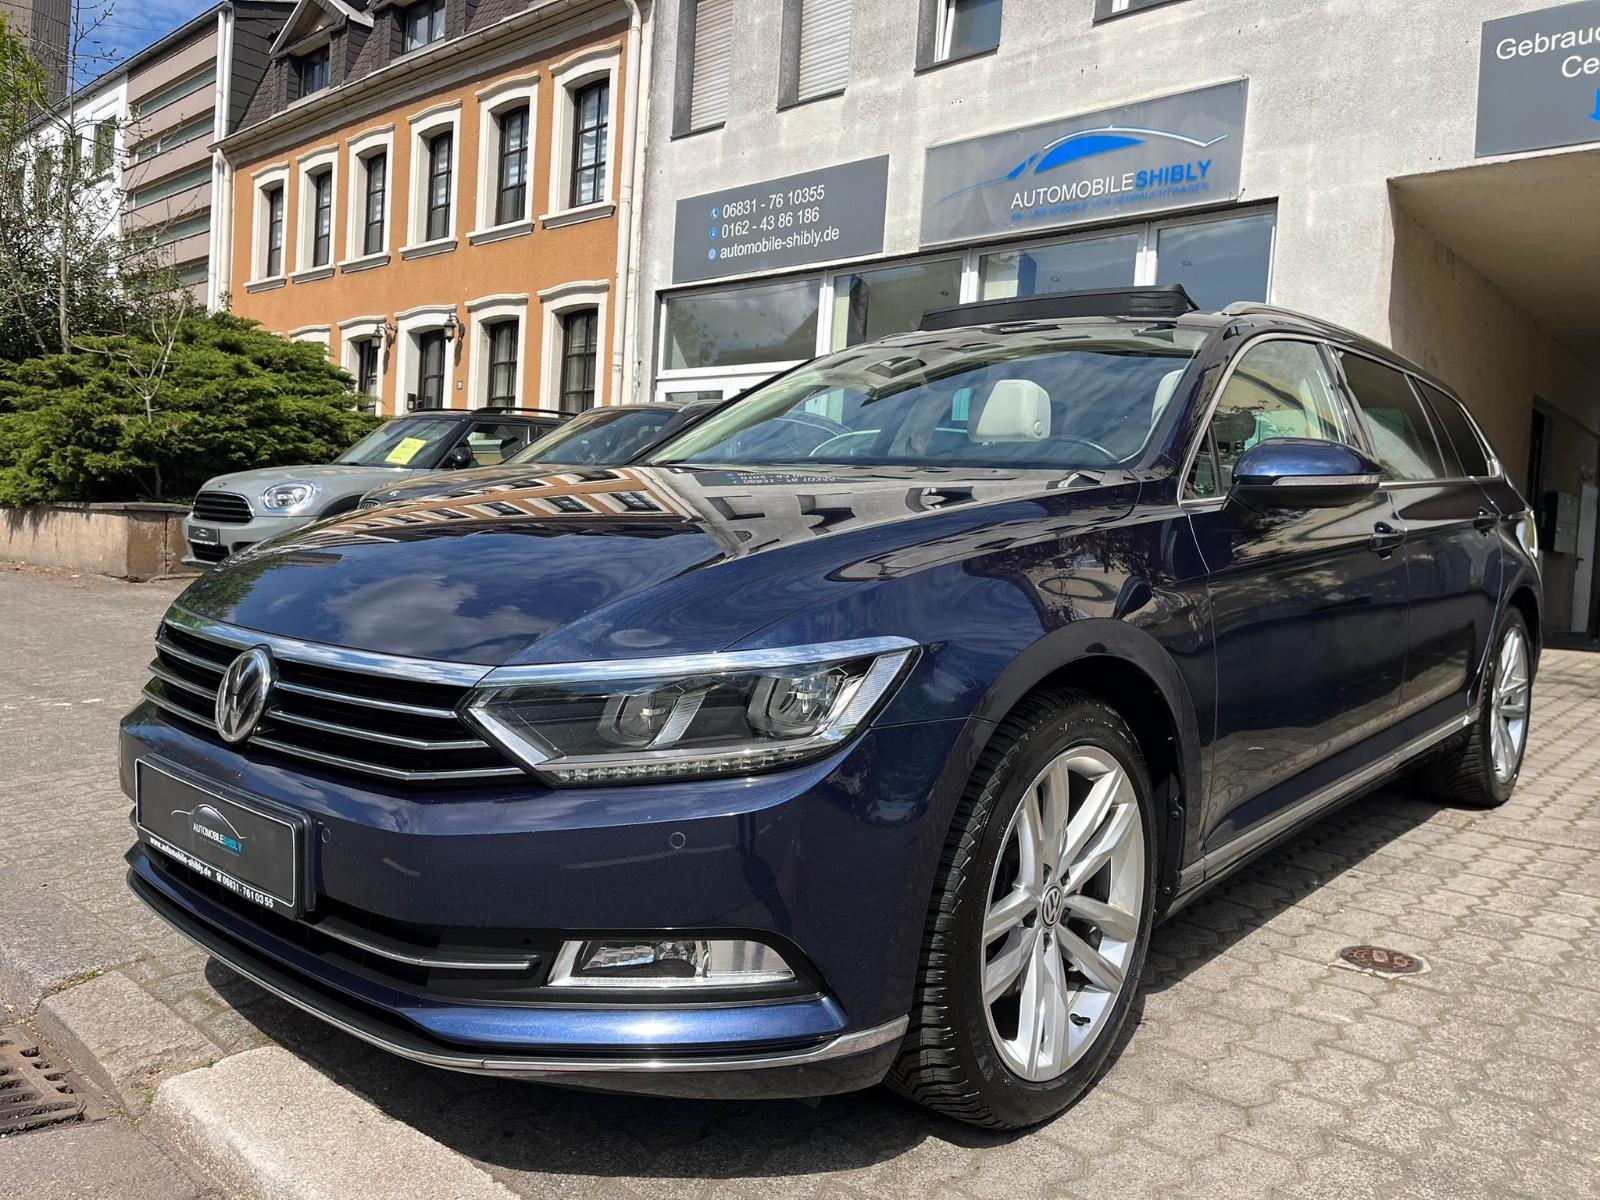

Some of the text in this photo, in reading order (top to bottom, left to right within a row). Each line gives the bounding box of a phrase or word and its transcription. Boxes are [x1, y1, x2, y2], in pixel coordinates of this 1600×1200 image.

[722, 198, 757, 219] 06831
[769, 193, 784, 209] 76
[787, 184, 825, 206] 10355
[1011, 159, 1212, 210] AUTOMOBILESHIBLY
[721, 220, 750, 239] 0162
[759, 215, 775, 231] 43
[777, 211, 793, 228] 86
[797, 206, 820, 224] 186
[719, 225, 840, 259] automobile-shibly.de
